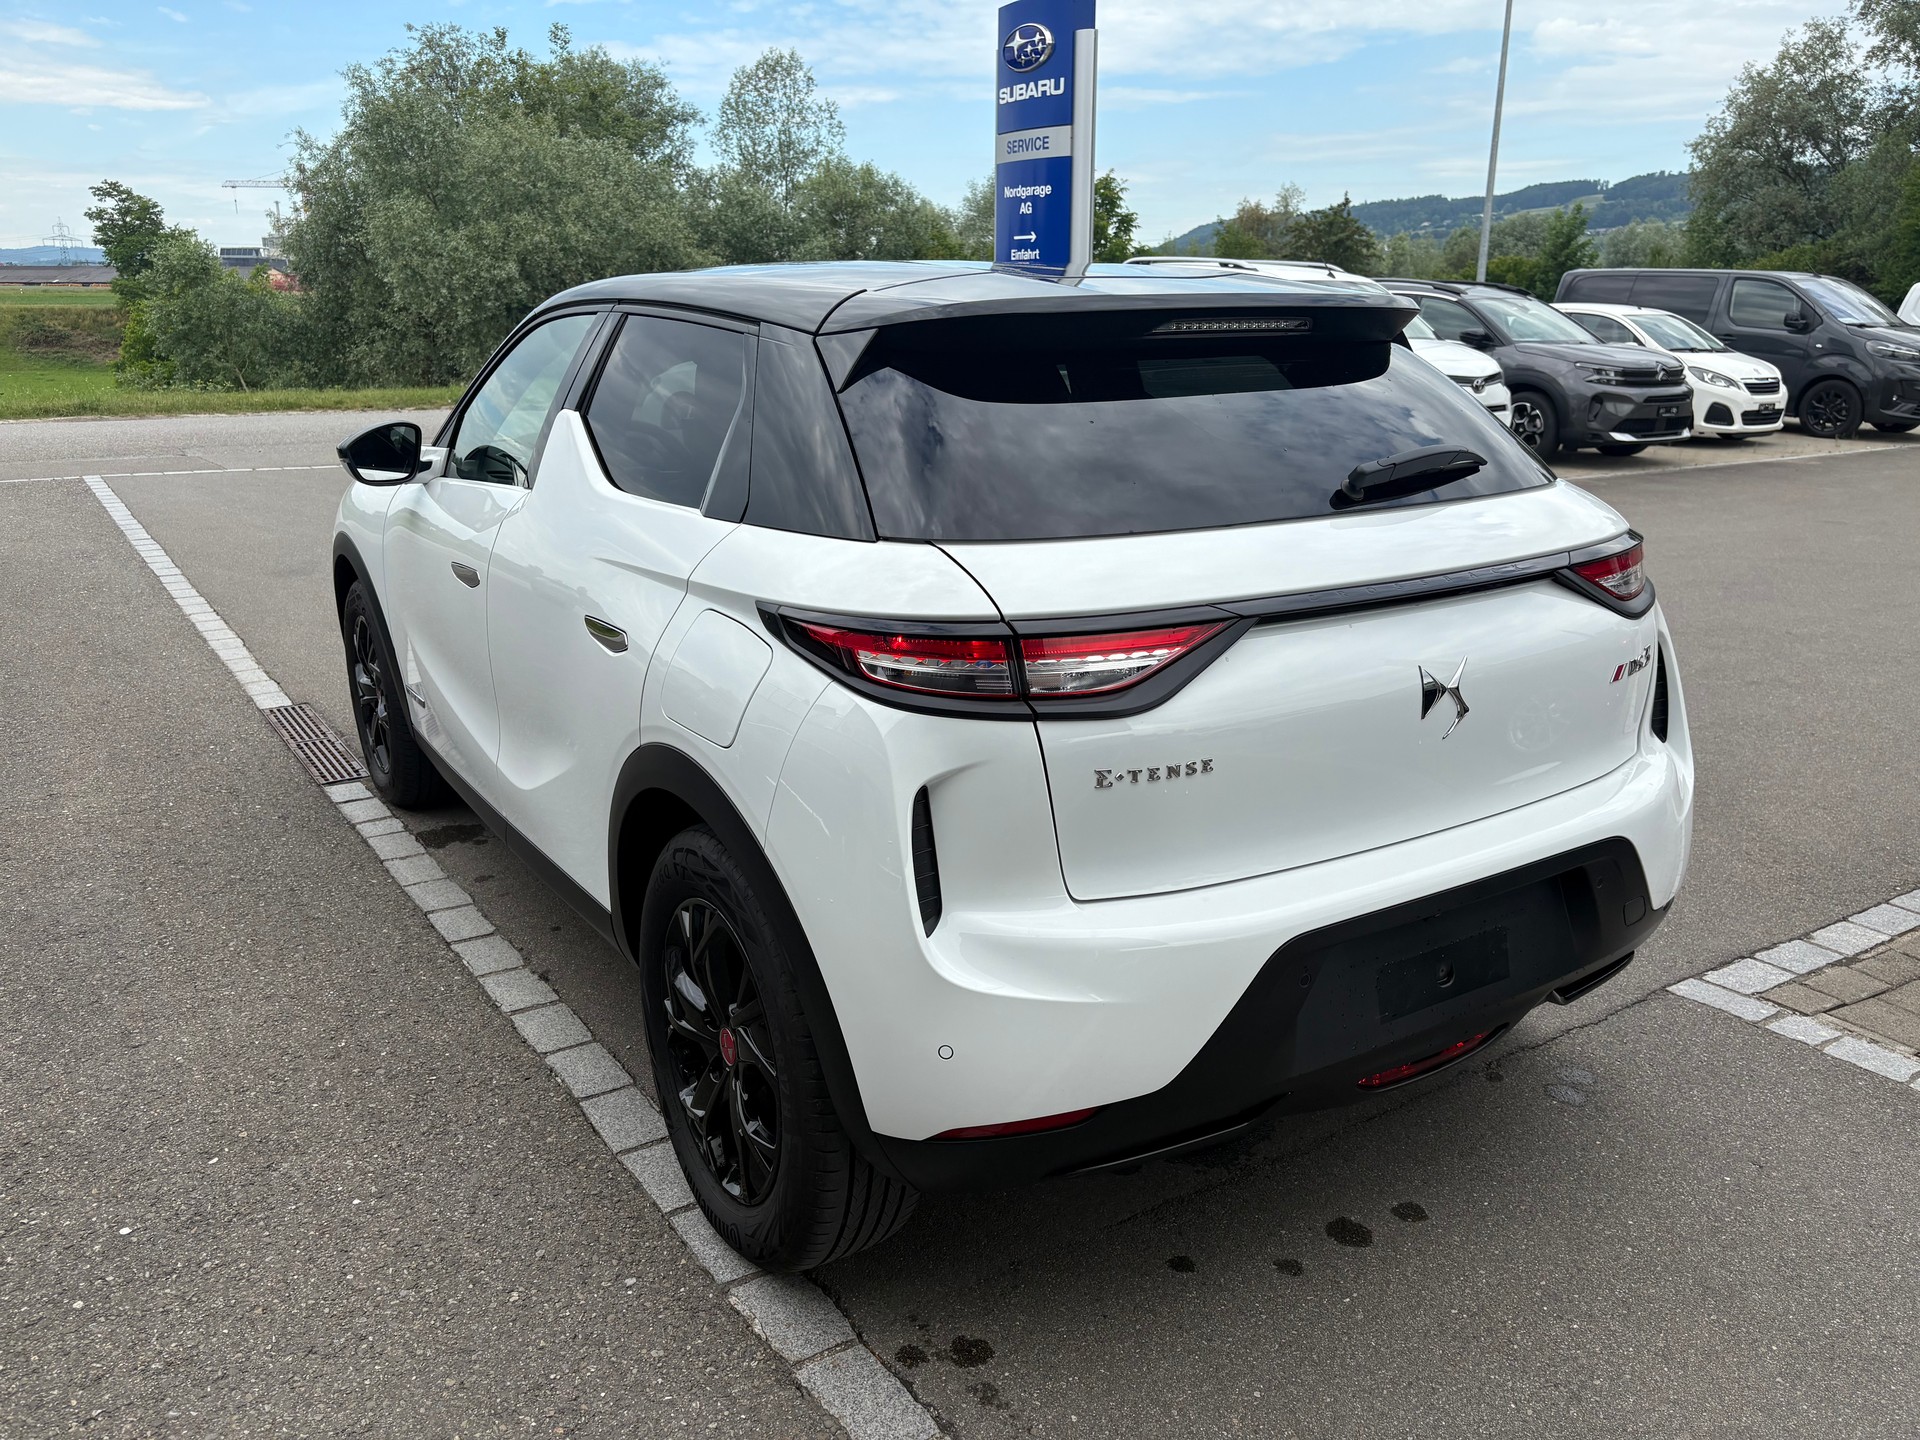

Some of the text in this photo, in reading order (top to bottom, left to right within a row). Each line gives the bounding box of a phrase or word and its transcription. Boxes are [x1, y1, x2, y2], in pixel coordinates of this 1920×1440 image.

[999, 77, 1065, 105] SUBARU
[1006, 136, 1050, 155] SERVICE
[1004, 185, 1052, 199] Nordgarage
[1019, 202, 1033, 215] AG
[1010, 248, 1040, 261] Einfahrt
